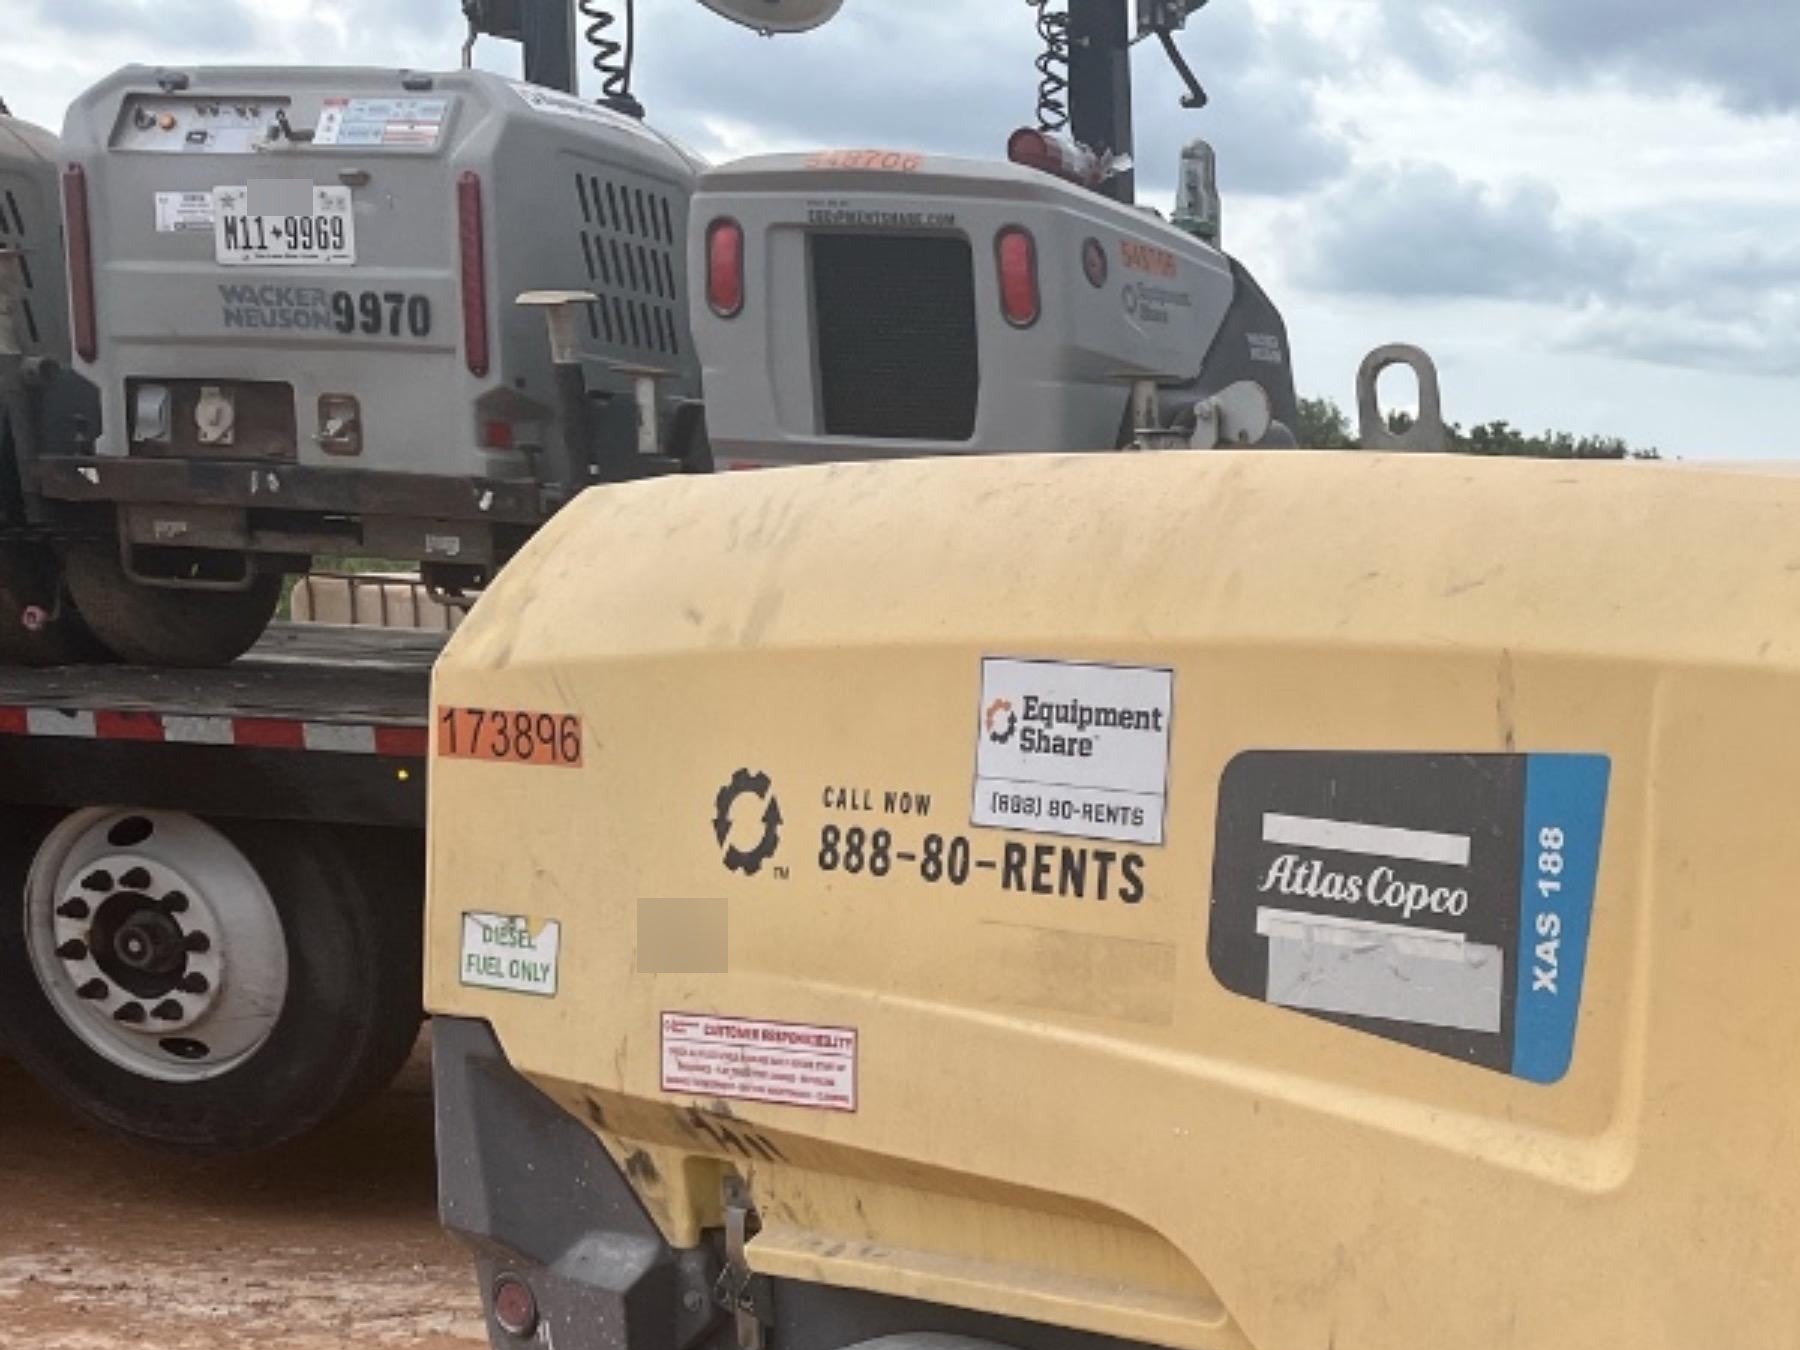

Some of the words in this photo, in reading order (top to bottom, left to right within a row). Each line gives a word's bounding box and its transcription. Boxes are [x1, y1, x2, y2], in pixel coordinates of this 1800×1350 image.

[218, 285, 327, 307] WACKER
[332, 290, 432, 337] 9970
[222, 305, 333, 330] NEUSON
[1022, 695, 1163, 732] Equipment
[442, 708, 581, 763] 173896
[1019, 726, 1094, 757] Share
[823, 786, 874, 811] CALL
[884, 791, 931, 817] NOW
[818, 823, 1145, 904] 888-80-RENTS
[1538, 826, 1565, 898] 188
[1258, 854, 1363, 904] Atlas
[1366, 866, 1469, 919] Copco
[482, 920, 537, 951] DIESEL
[1532, 912, 1561, 994] XAS
[465, 953, 505, 979] FUEL
[509, 959, 551, 983] ONLY
